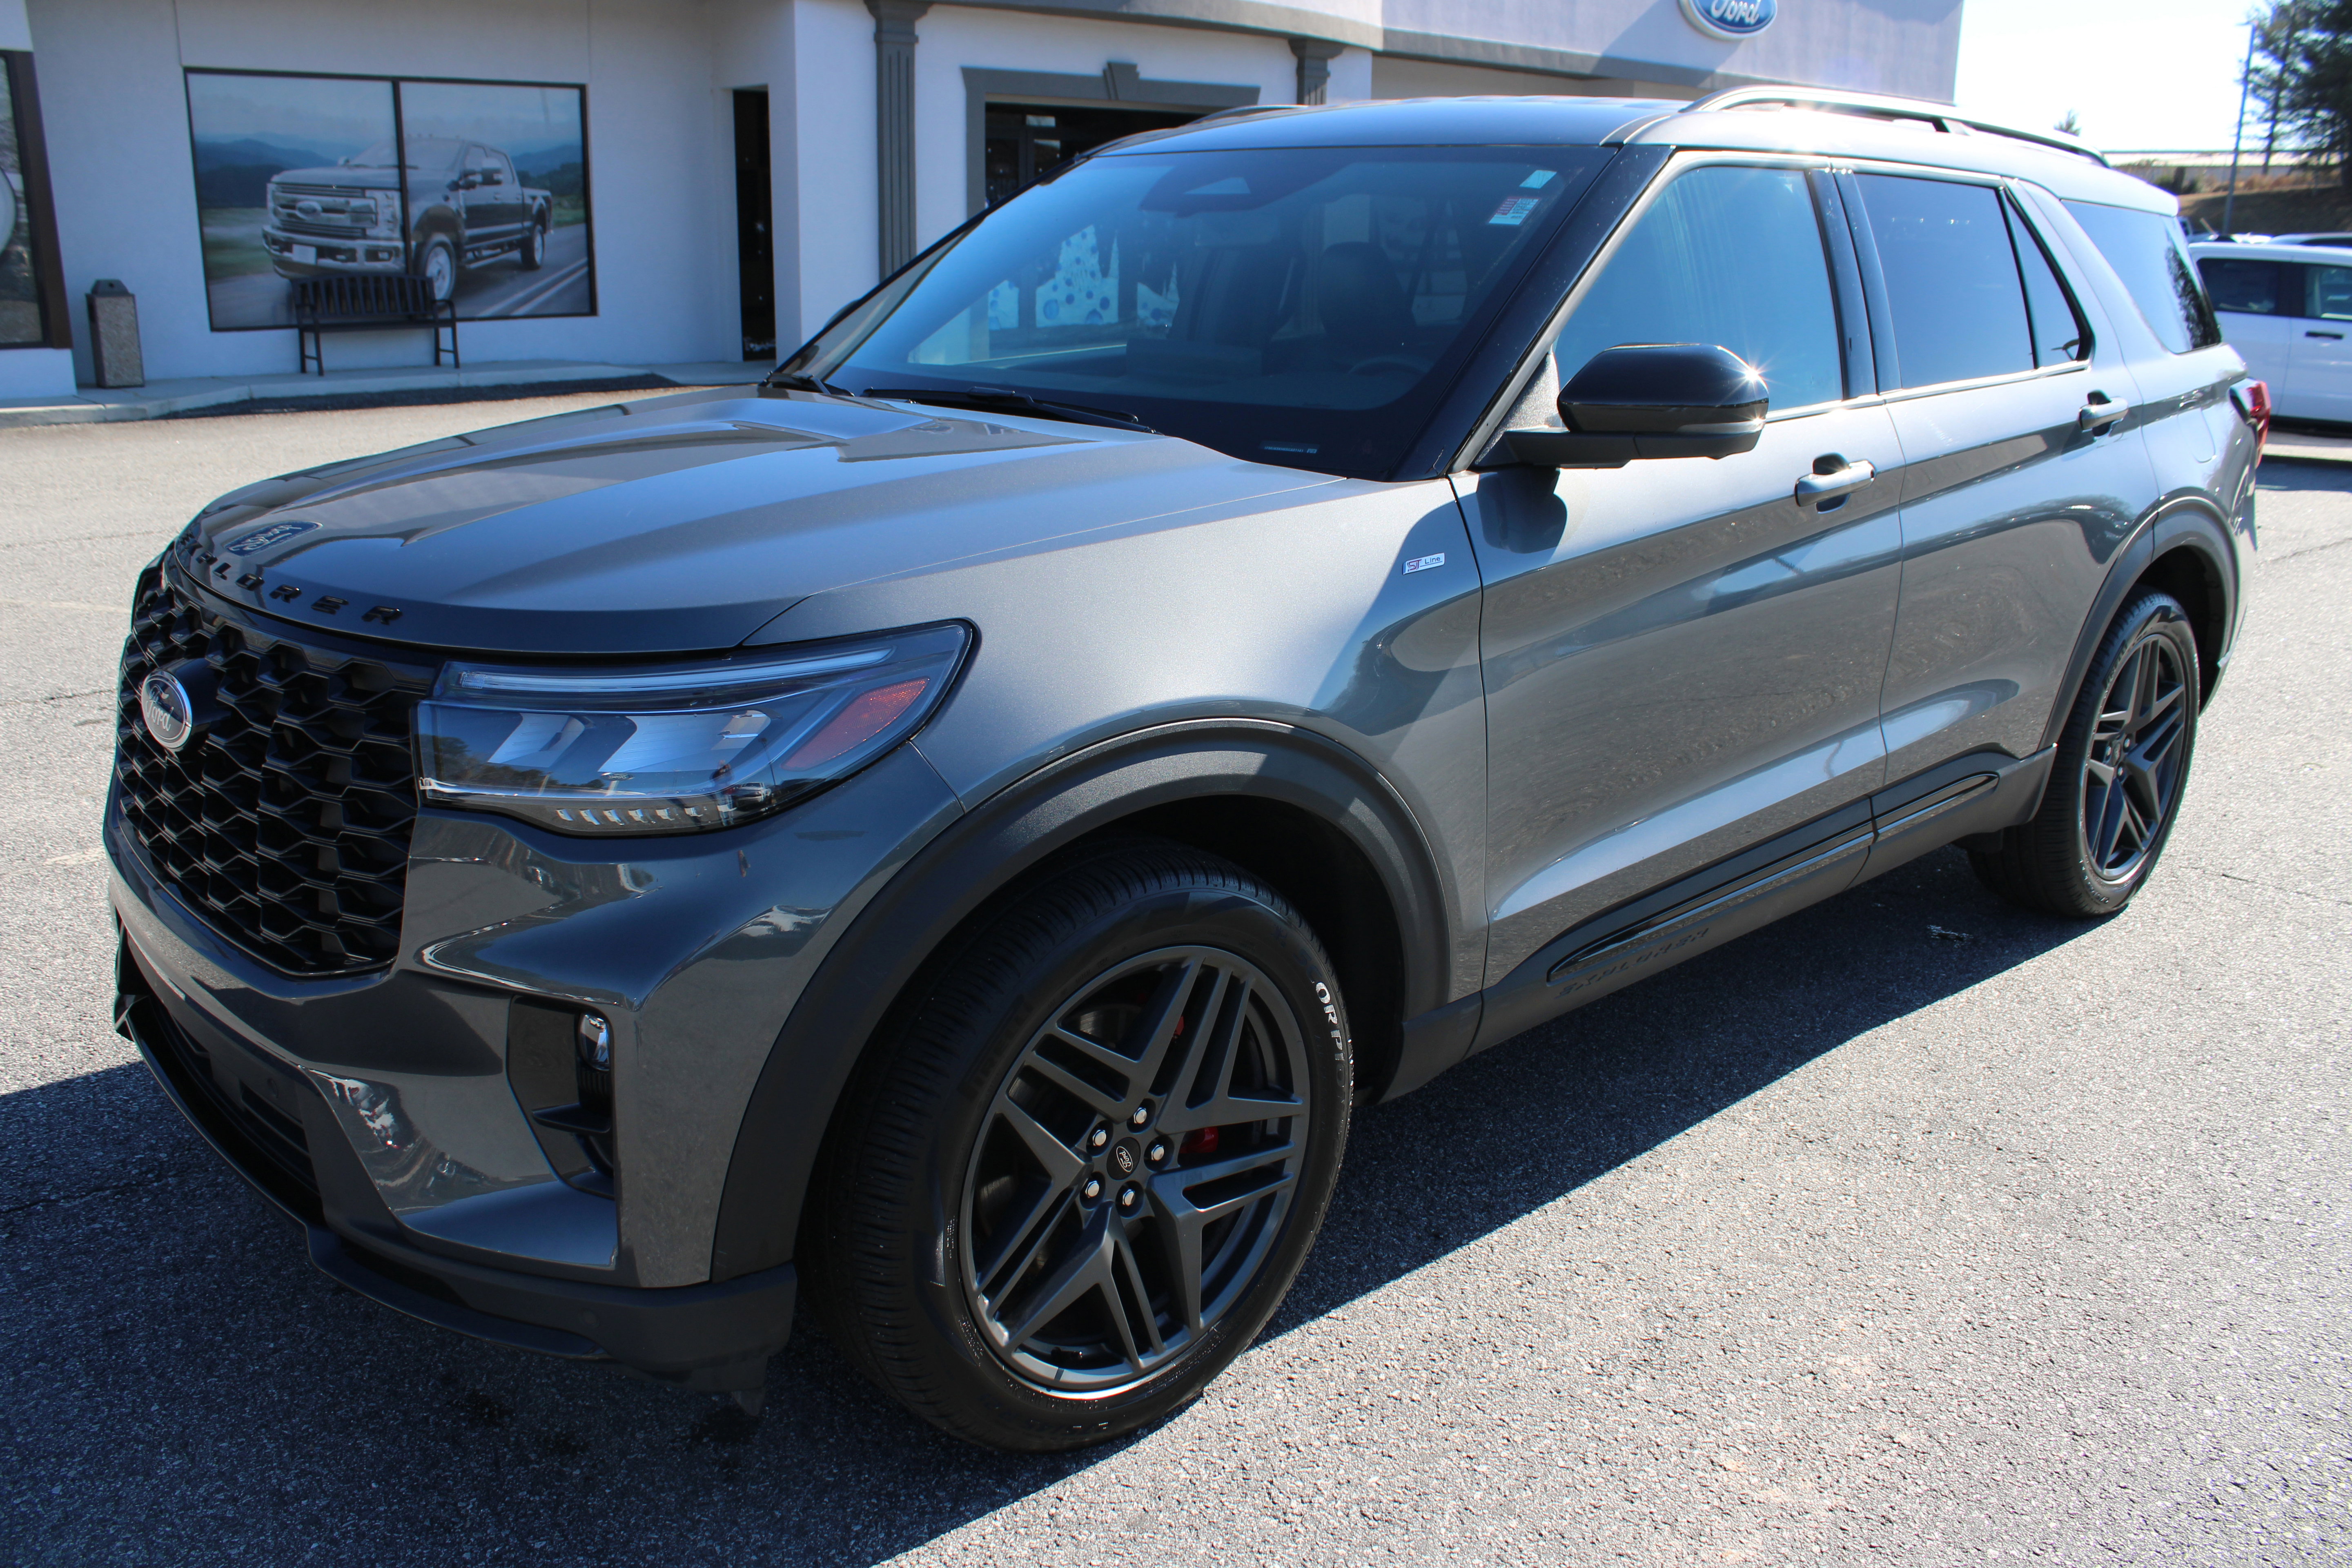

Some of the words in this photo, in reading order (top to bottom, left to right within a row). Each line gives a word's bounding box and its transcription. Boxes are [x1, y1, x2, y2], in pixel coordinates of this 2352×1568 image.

[1407, 559, 1422, 571] ST
[145, 685, 174, 732] Ford
[1119, 1150, 1131, 1168] Ford
